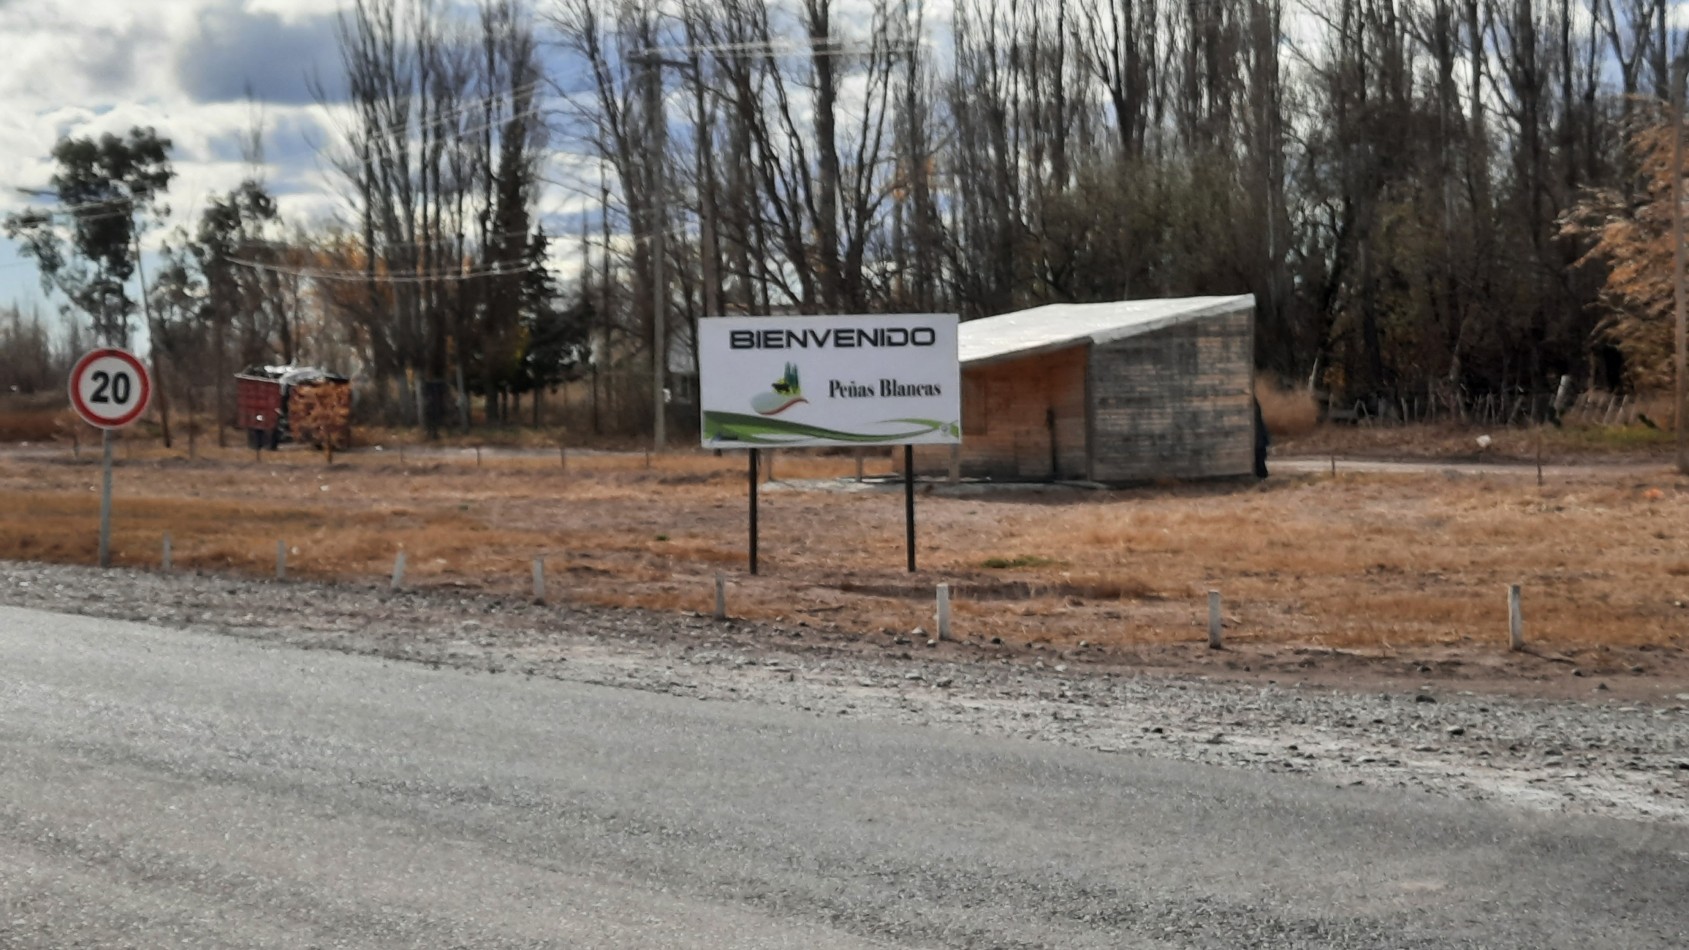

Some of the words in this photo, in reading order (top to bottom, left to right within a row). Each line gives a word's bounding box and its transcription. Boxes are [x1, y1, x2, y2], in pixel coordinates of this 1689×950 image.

[730, 328, 936, 349] BIENVENIDO
[90, 371, 131, 405] 20
[829, 379, 875, 398] Peñas
[879, 378, 942, 397] Blancas
